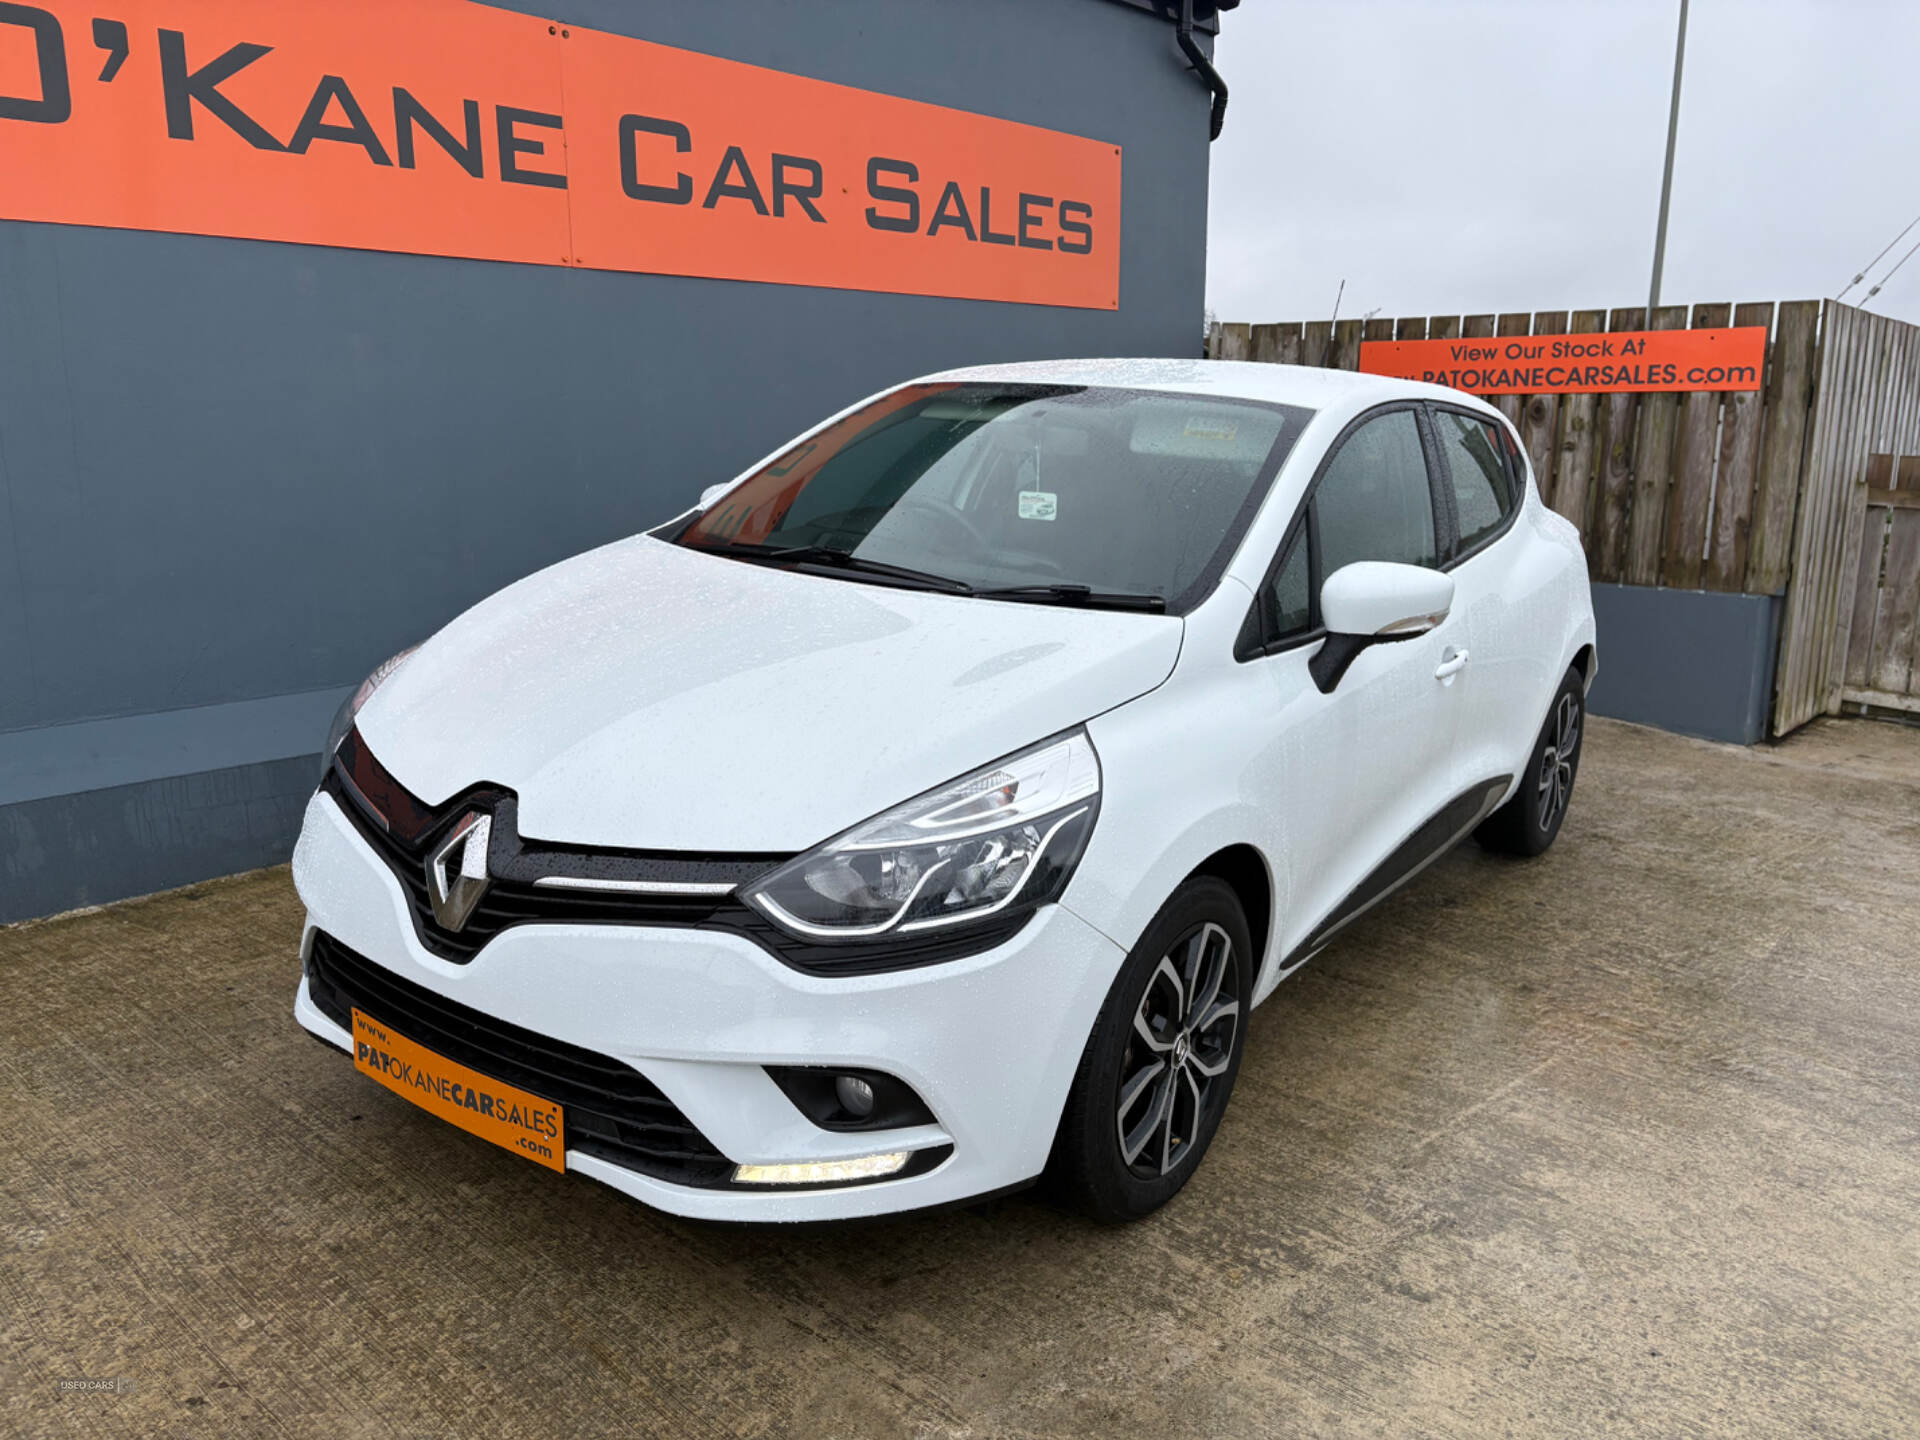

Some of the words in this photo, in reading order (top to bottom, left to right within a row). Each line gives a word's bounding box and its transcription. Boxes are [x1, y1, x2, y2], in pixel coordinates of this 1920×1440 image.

[618, 114, 827, 223] CAR
[866, 157, 1093, 255] SALES
[1450, 345, 1498, 361] View
[1505, 343, 1545, 360] Our
[1551, 339, 1614, 358] Stock
[1620, 338, 1646, 356] At
[1392, 364, 1756, 388] PATOKANECARSALES.com
[357, 1018, 391, 1045] www.
[358, 1041, 558, 1137] PATOKANECARSALES
[515, 1137, 553, 1159] .com
